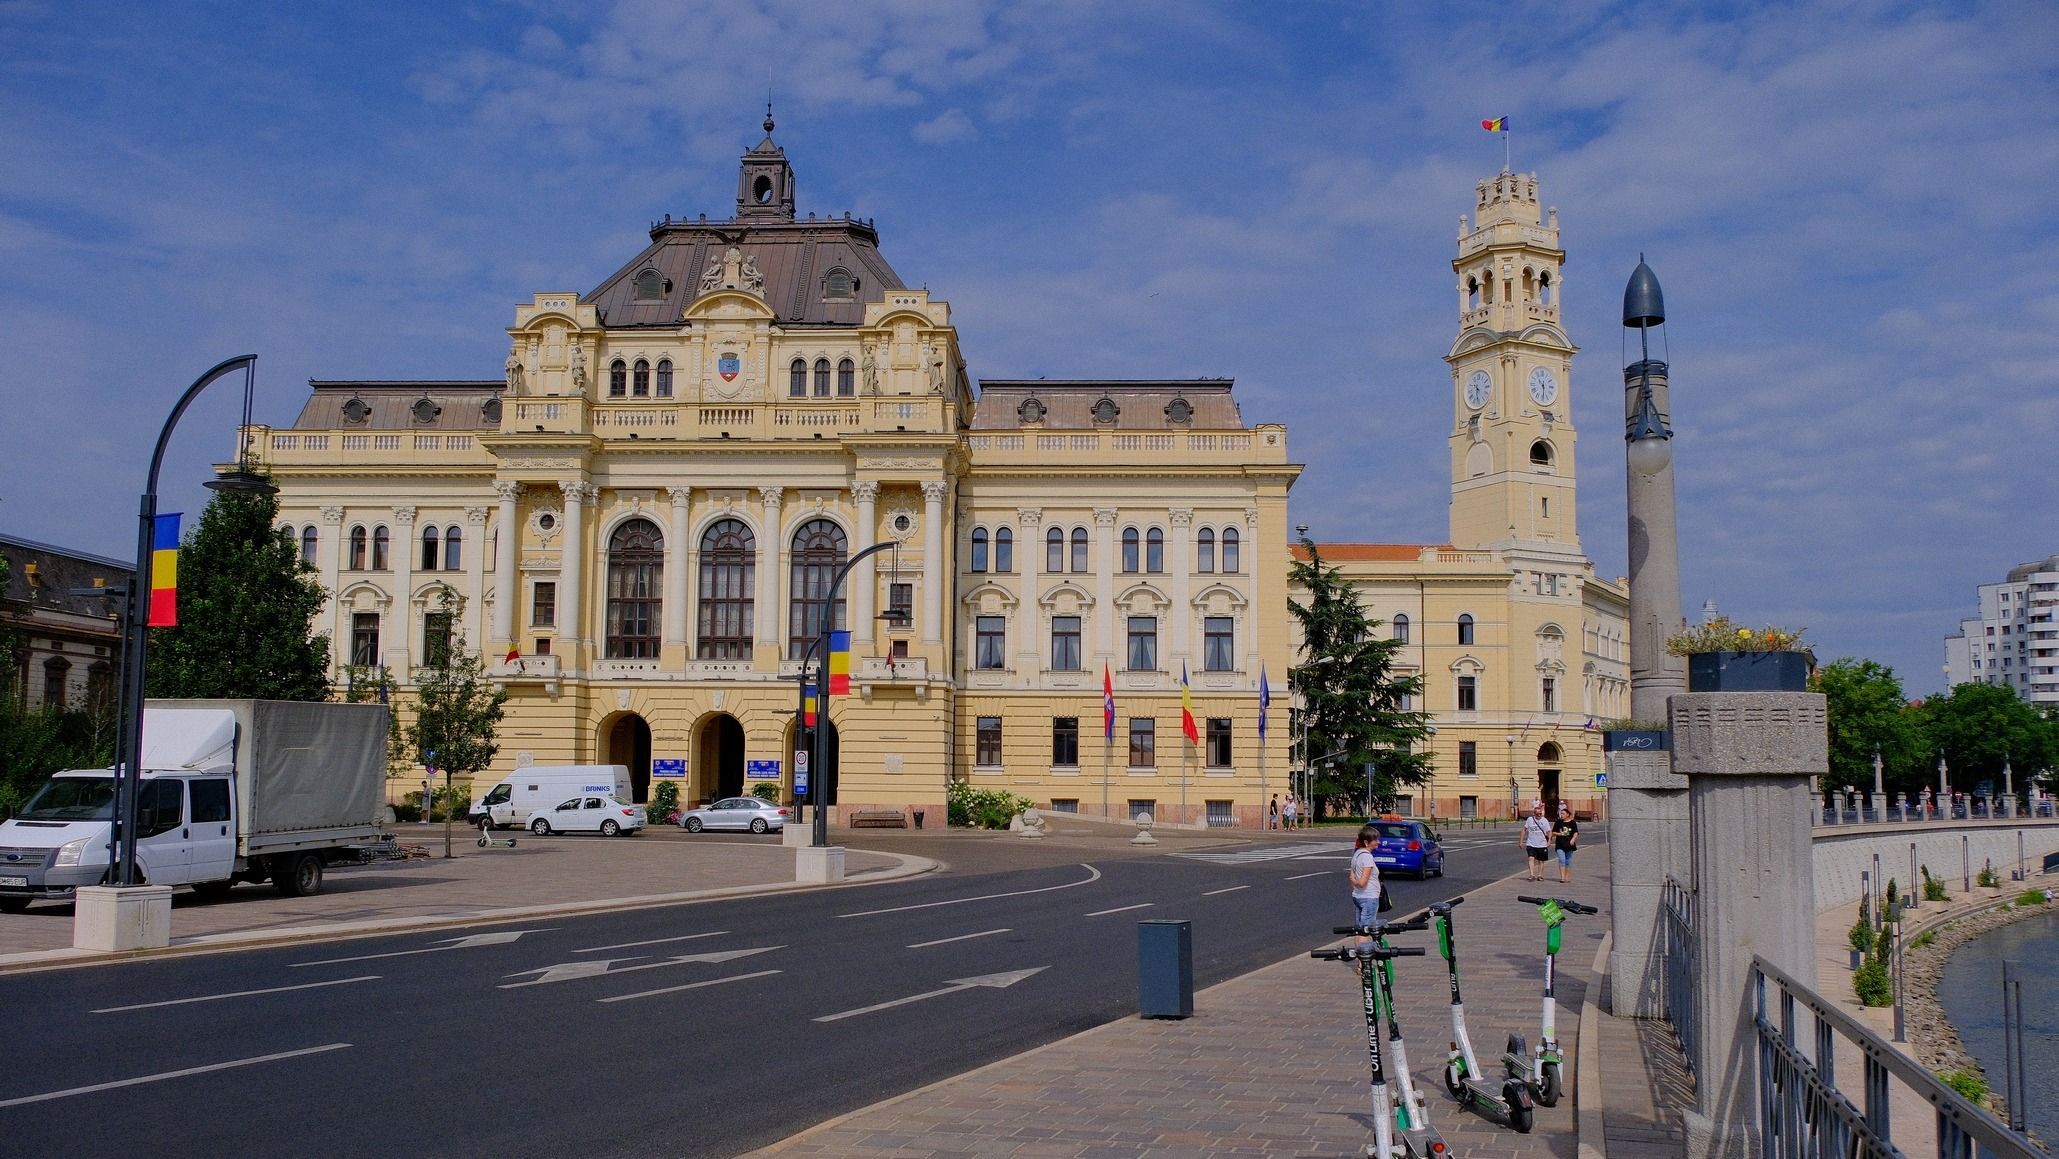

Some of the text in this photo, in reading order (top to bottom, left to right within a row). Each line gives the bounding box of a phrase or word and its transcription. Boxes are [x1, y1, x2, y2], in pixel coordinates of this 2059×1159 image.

[1364, 986, 1374, 1014] Uber
[1368, 1025, 1378, 1053] Lime
[1371, 1055, 1379, 1072] On
